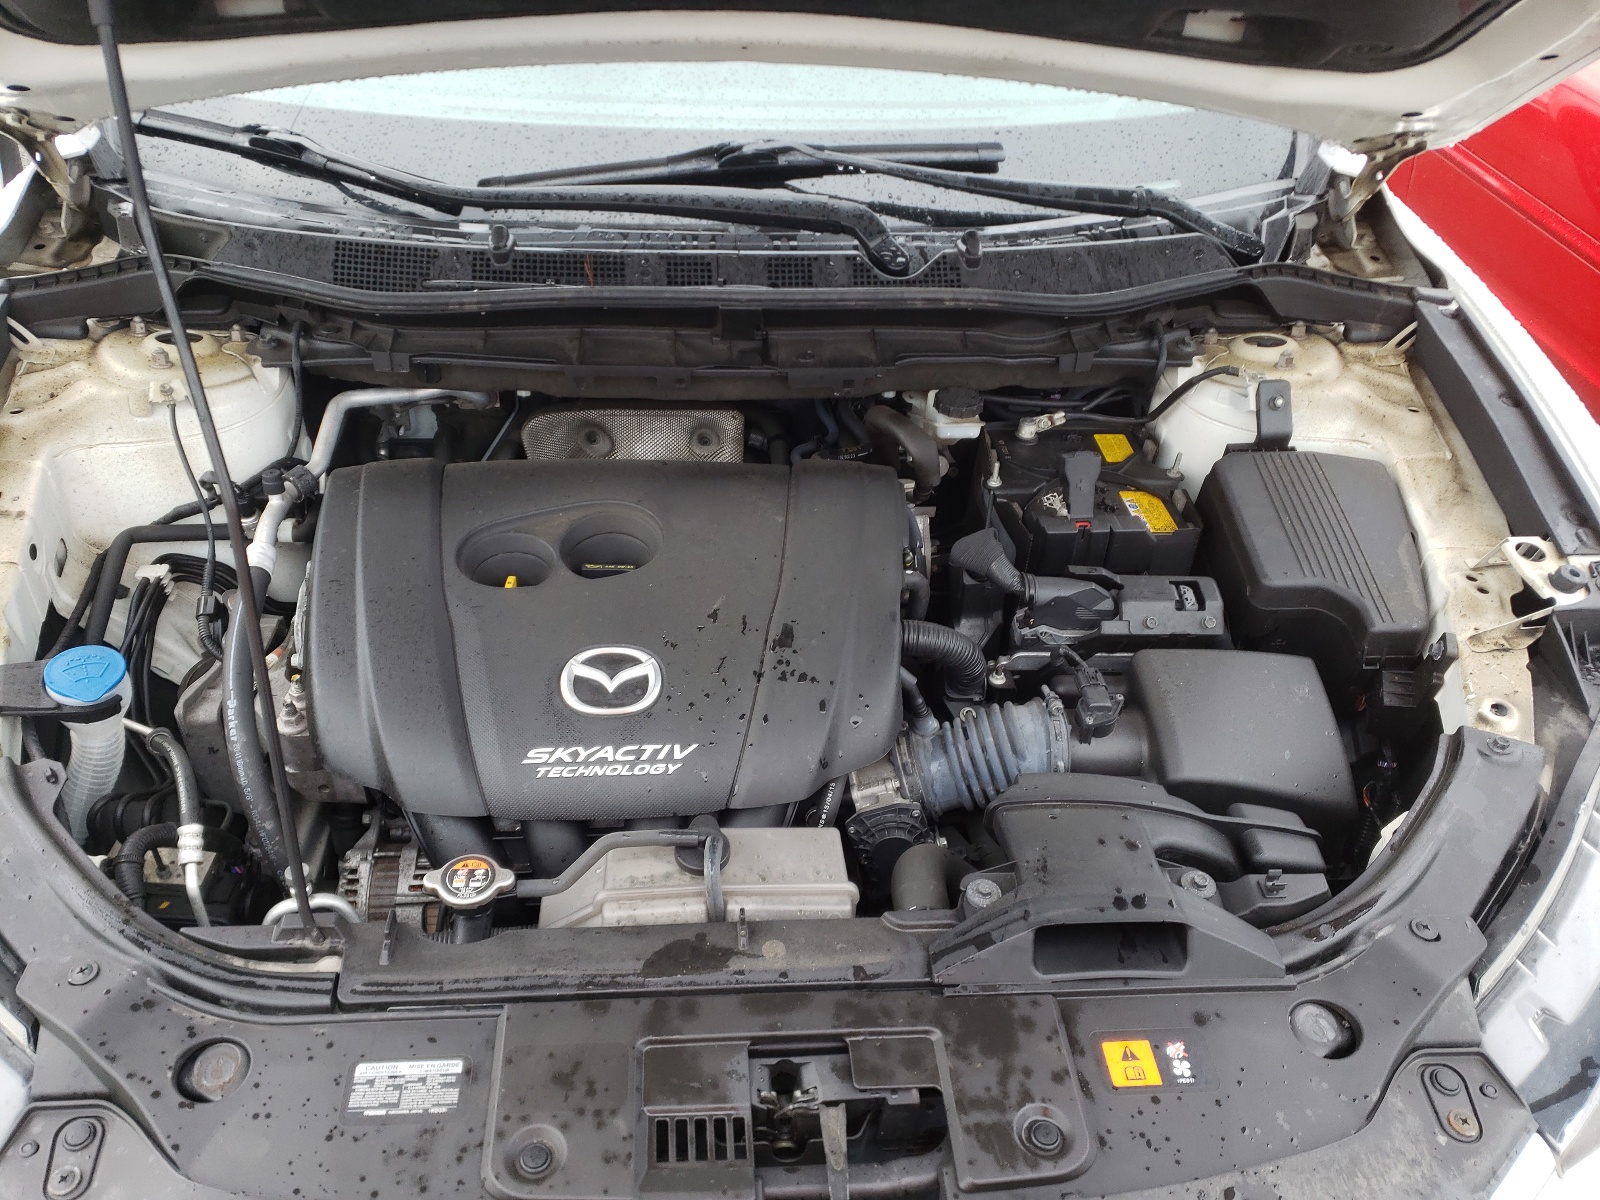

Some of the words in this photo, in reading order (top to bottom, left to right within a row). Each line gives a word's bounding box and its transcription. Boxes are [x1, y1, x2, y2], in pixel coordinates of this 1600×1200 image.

[226, 699, 238, 741] Parker
[521, 743, 700, 764] SKYACTIV
[535, 763, 683, 779] TECHNOLOGY
